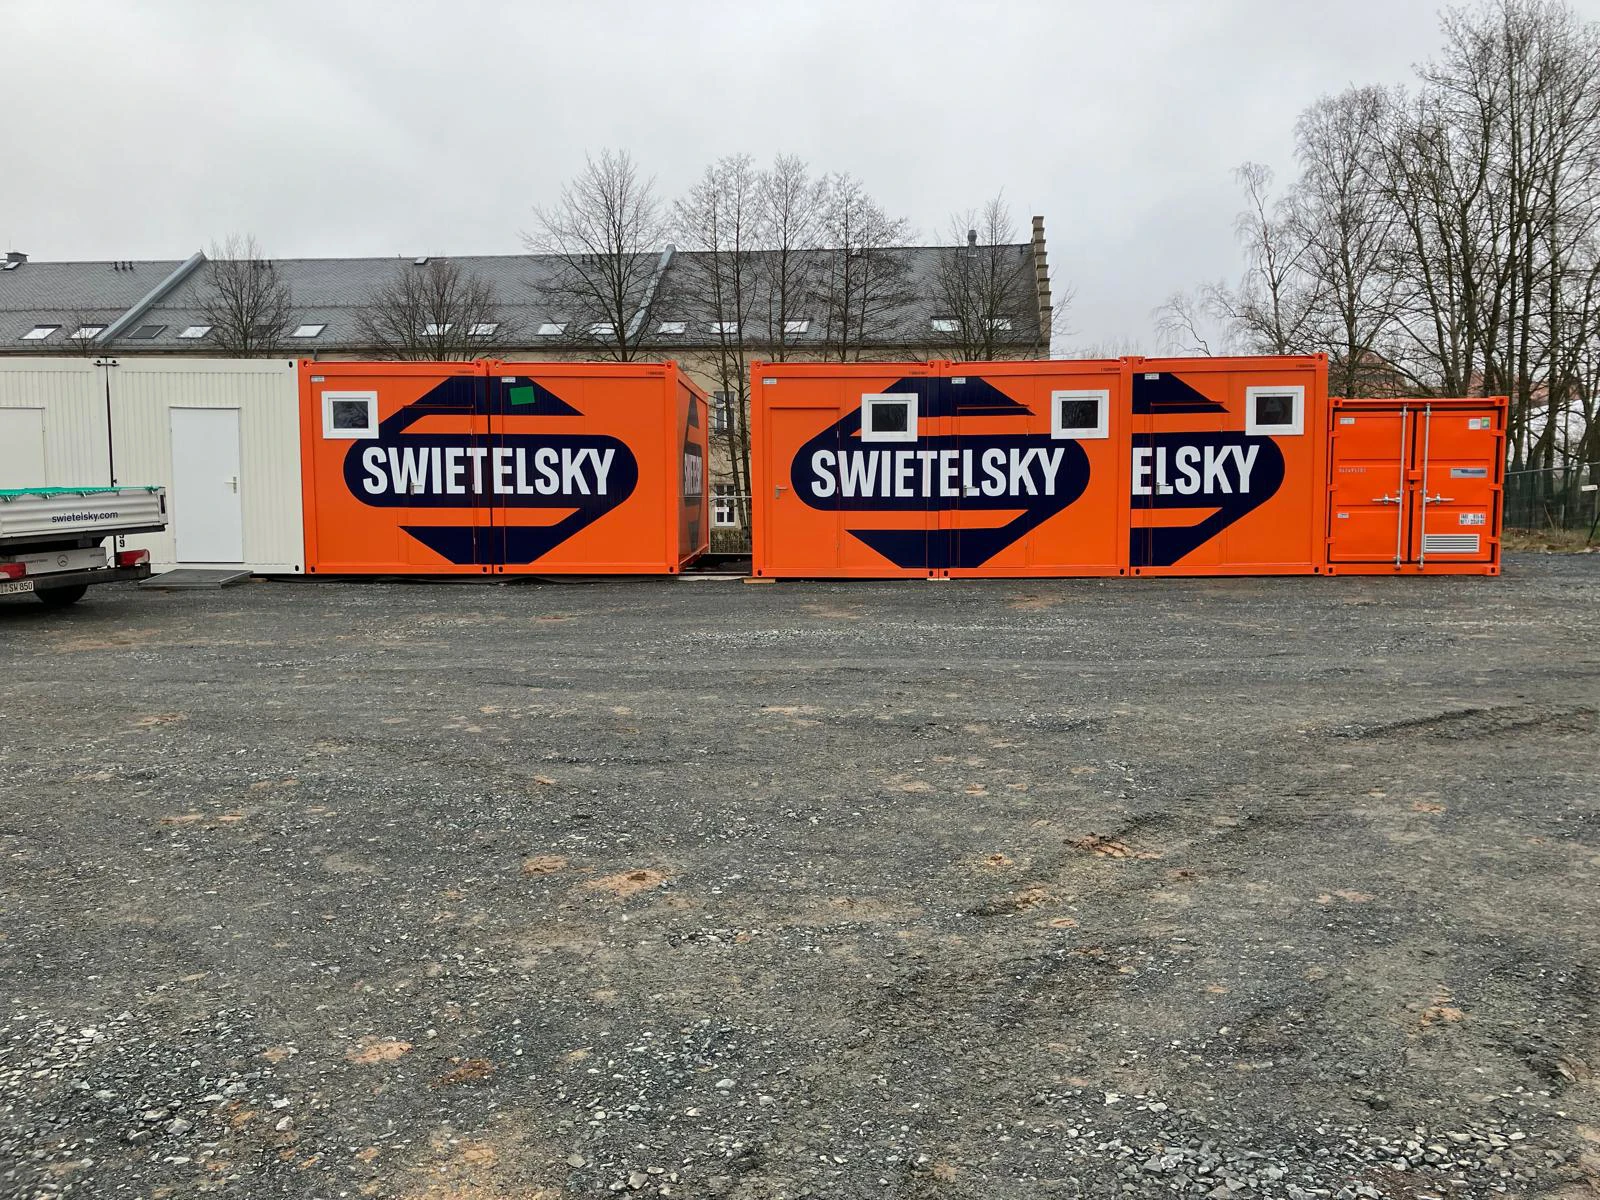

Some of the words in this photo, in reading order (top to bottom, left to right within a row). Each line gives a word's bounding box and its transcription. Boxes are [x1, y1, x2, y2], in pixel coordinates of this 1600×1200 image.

[362, 446, 615, 496] SWIETELSKY
[811, 447, 1065, 498] SWIETELSKY
[1131, 444, 1260, 496] ELSKY
[51, 511, 118, 523] swietelsky.com
[19, 581, 33, 591] 850
